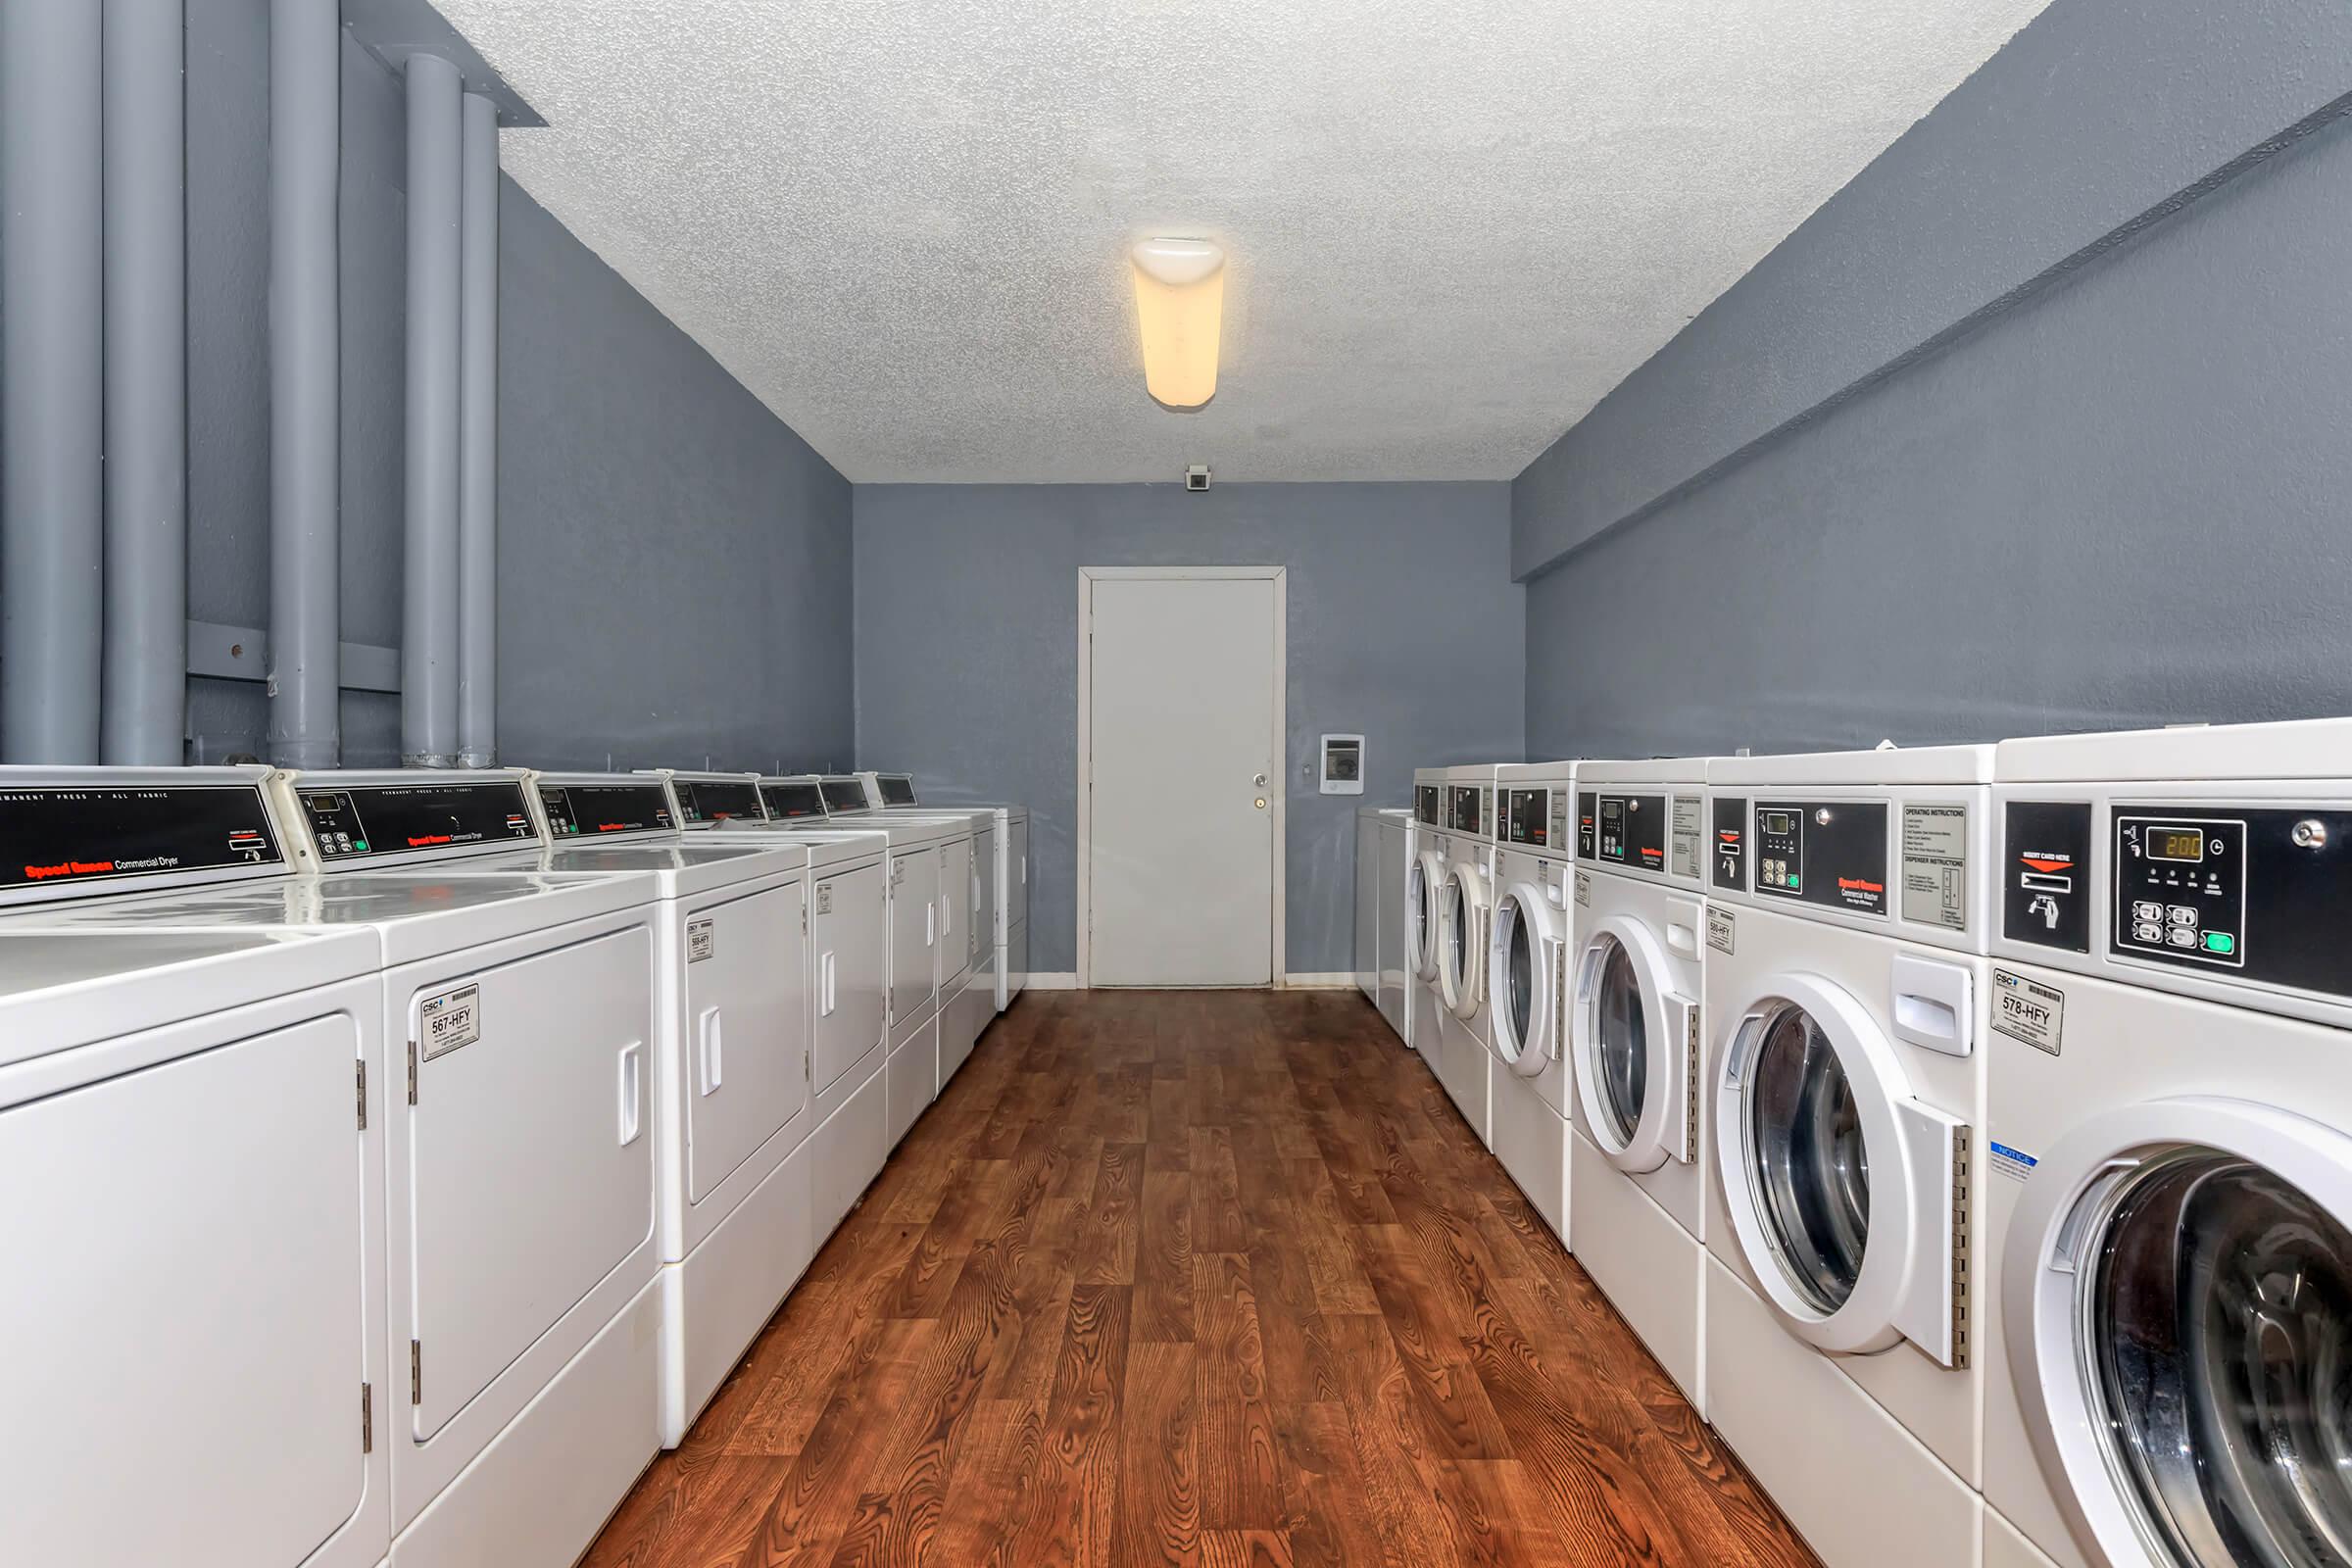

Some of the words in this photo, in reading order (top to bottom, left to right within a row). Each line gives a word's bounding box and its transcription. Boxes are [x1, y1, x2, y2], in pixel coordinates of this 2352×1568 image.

[24, 862, 71, 879] Speed
[115, 858, 159, 870] Commercial
[158, 857, 178, 868] Dryer
[2055, 854, 2071, 862] HERE
[1995, 973, 2014, 985] CSC
[432, 1007, 471, 1035] 567-HFY
[2002, 996, 2050, 1025] 578-HFY
